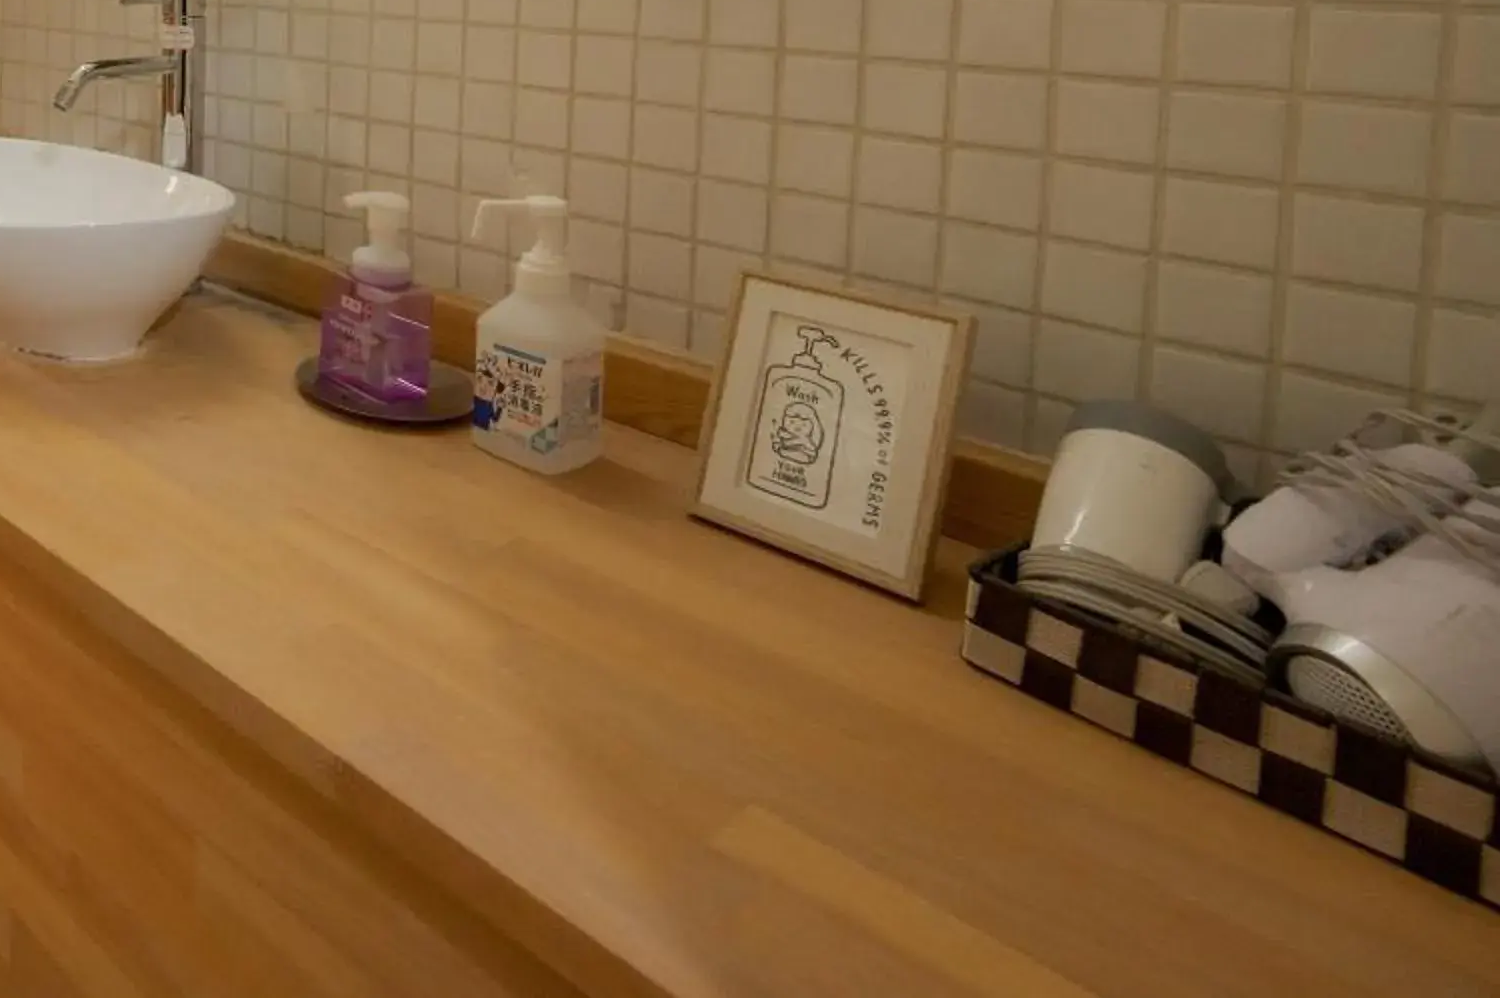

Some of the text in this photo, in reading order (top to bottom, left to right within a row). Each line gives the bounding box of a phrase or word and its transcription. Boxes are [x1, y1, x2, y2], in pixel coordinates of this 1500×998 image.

[786, 383, 820, 404] Wash
[840, 348, 884, 397] KILLS
[862, 471, 888, 529] GERMS
